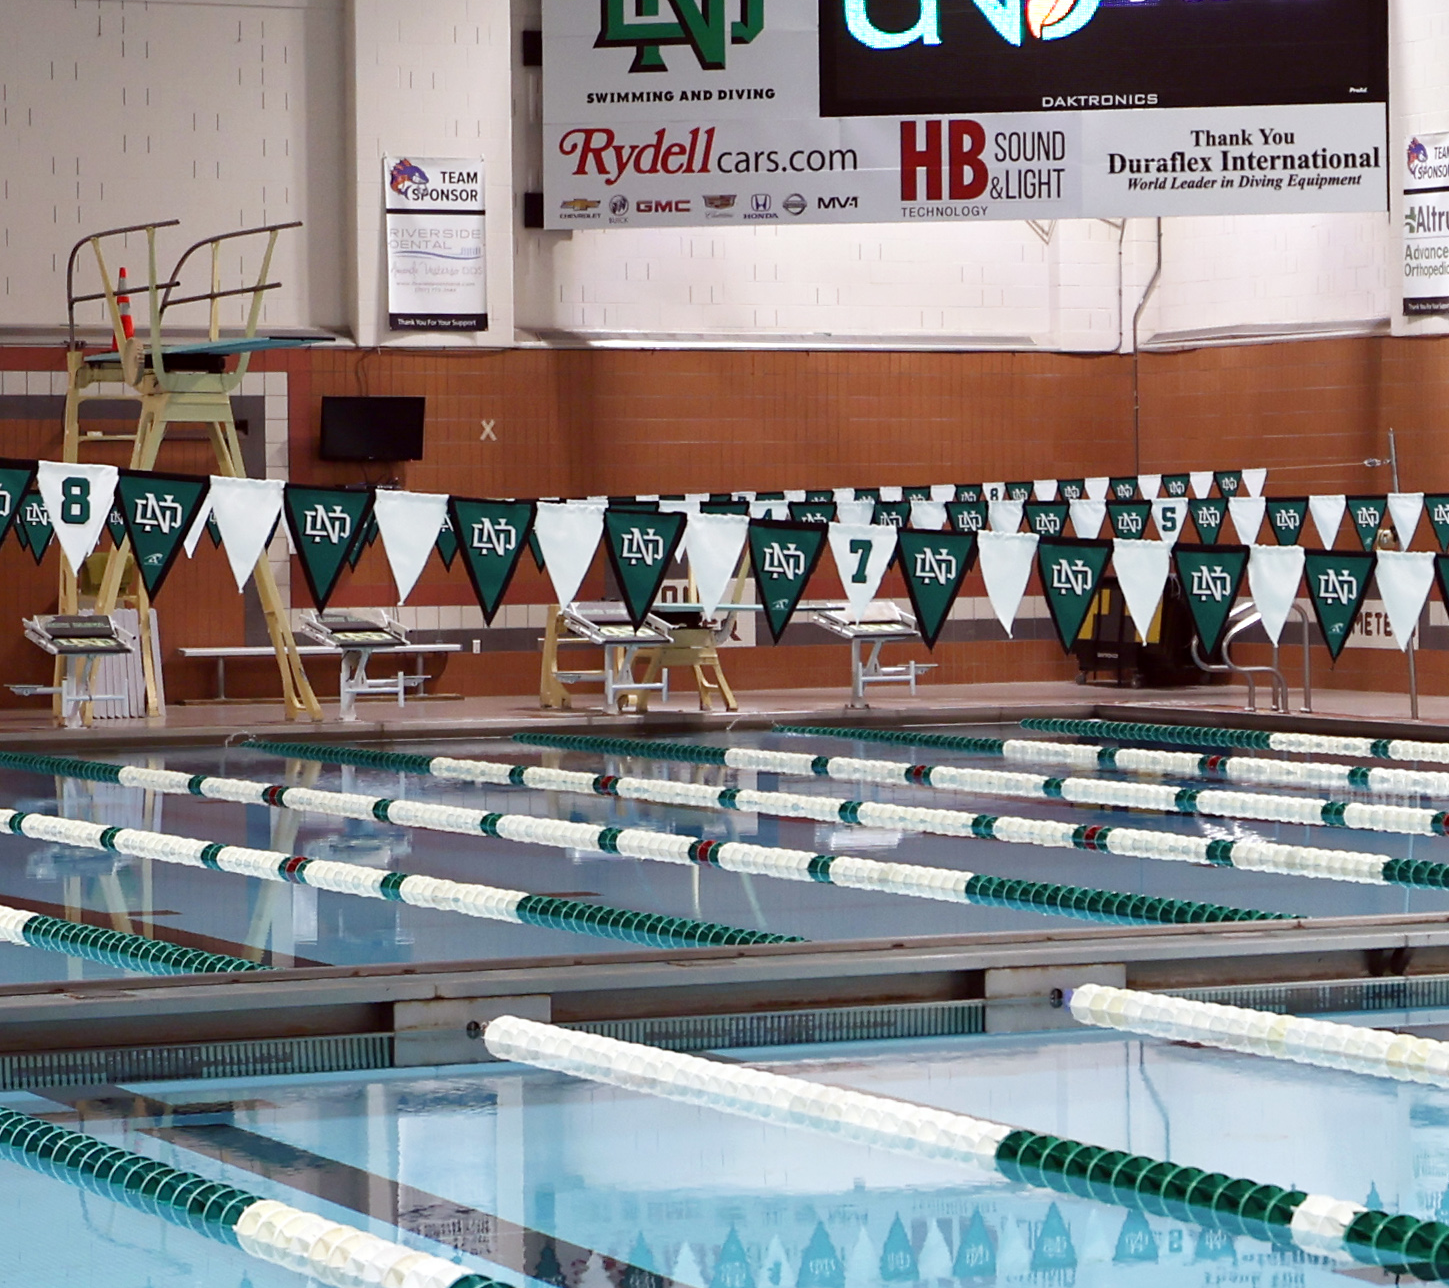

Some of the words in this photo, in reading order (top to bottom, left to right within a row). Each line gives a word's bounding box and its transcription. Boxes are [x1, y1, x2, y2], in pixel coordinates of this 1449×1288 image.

[587, 91, 674, 103] SWIMMING
[679, 90, 713, 101] AND
[717, 88, 775, 100] DIVING
[1042, 93, 1158, 107] DAKTRONICS
[1190, 129, 1253, 147] Thank
[1259, 128, 1294, 146] You
[995, 131, 1065, 162] SOUND
[900, 120, 989, 201] HB
[1108, 152, 1212, 174] Duraflex
[1221, 147, 1380, 172] International
[441, 172, 478, 184] TEAM
[1128, 177, 1166, 191] World
[1171, 177, 1217, 190] Leader
[1221, 176, 1234, 188] in
[1238, 175, 1283, 190] Diving
[1288, 174, 1362, 189] Equipment
[412, 189, 478, 202] SPONSOR
[636, 200, 691, 212] GMC
[901, 206, 988, 218] TECHNOLOGY
[390, 228, 481, 239] RIVERSIDE
[388, 239, 452, 249] DENTAL
[61, 476, 91, 525] 8
[1161, 506, 1177, 532] 5
[849, 539, 873, 583] 7
